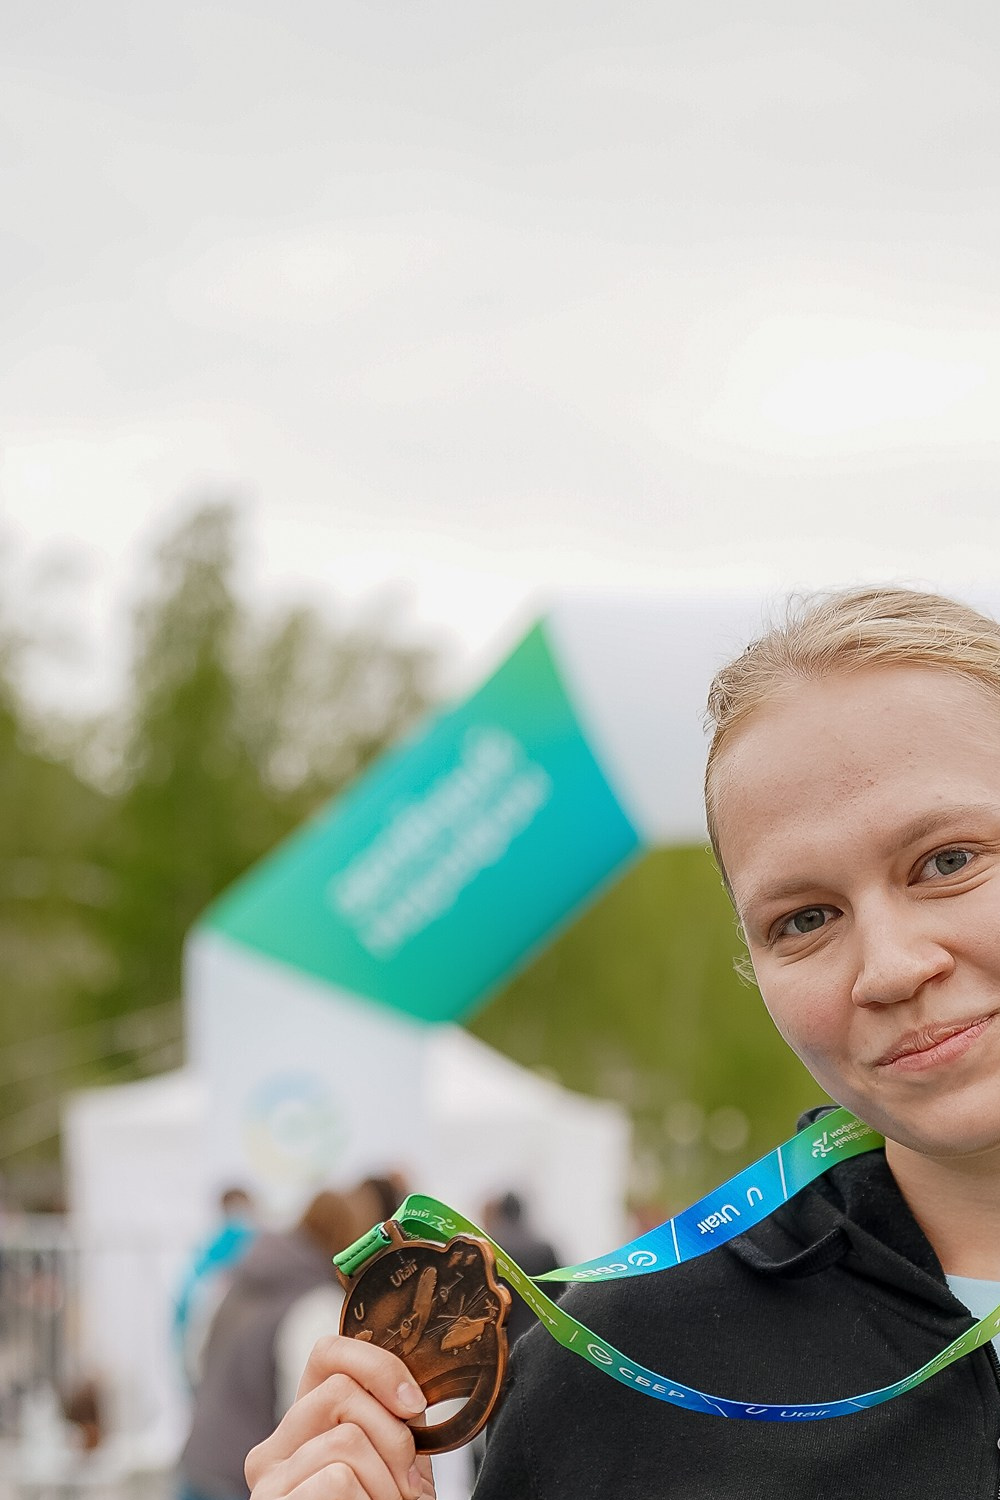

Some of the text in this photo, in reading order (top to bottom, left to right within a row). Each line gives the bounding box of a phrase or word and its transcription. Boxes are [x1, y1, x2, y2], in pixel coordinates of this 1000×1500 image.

[830, 1119, 866, 1139] арафон
[697, 1204, 740, 1235] Utair
[572, 1263, 628, 1279] СБЕР
[618, 1367, 685, 1398] СБЕР
[780, 1409, 830, 1418] Utair
